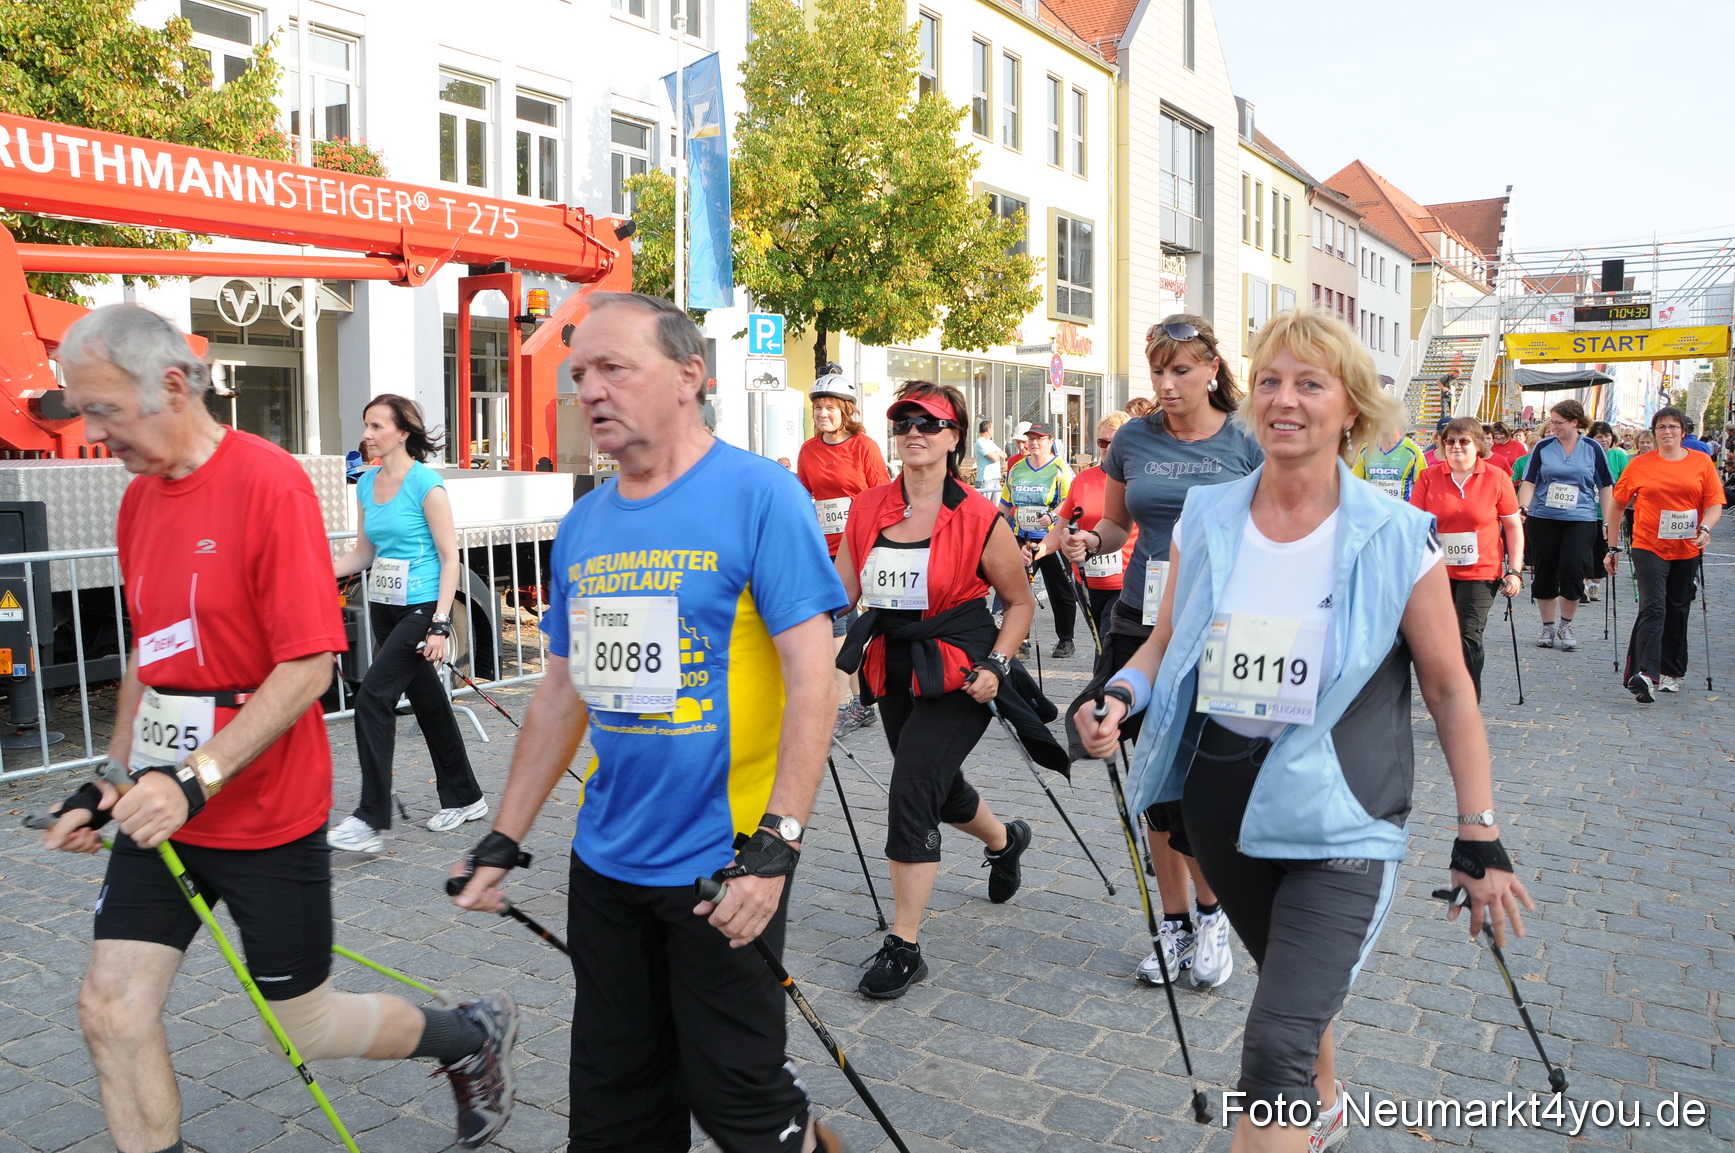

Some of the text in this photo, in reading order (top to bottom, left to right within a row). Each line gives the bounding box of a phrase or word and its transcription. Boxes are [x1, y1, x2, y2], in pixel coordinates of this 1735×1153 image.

[439, 197, 456, 230] T
[467, 202, 519, 239] 275
[1160, 249, 1187, 277] ltstadt
[756, 318, 776, 350] P
[1573, 335, 1649, 354] START
[1145, 457, 1222, 479] esprit
[1554, 493, 1575, 502] 8032
[826, 511, 849, 522] 8045
[1671, 521, 1695, 530] 8034
[1091, 555, 1117, 565] 8111
[1448, 545, 1474, 554] 8056
[584, 550, 718, 572] NEUMARKTER
[376, 575, 402, 589] 8036
[577, 571, 684, 597] STADTLAUF
[878, 570, 920, 588] 8117
[594, 606, 629, 627] Franz
[595, 641, 661, 673] 8088
[680, 670, 709, 688] 009
[1233, 652, 1308, 685] 8119
[142, 717, 198, 751] 8025
